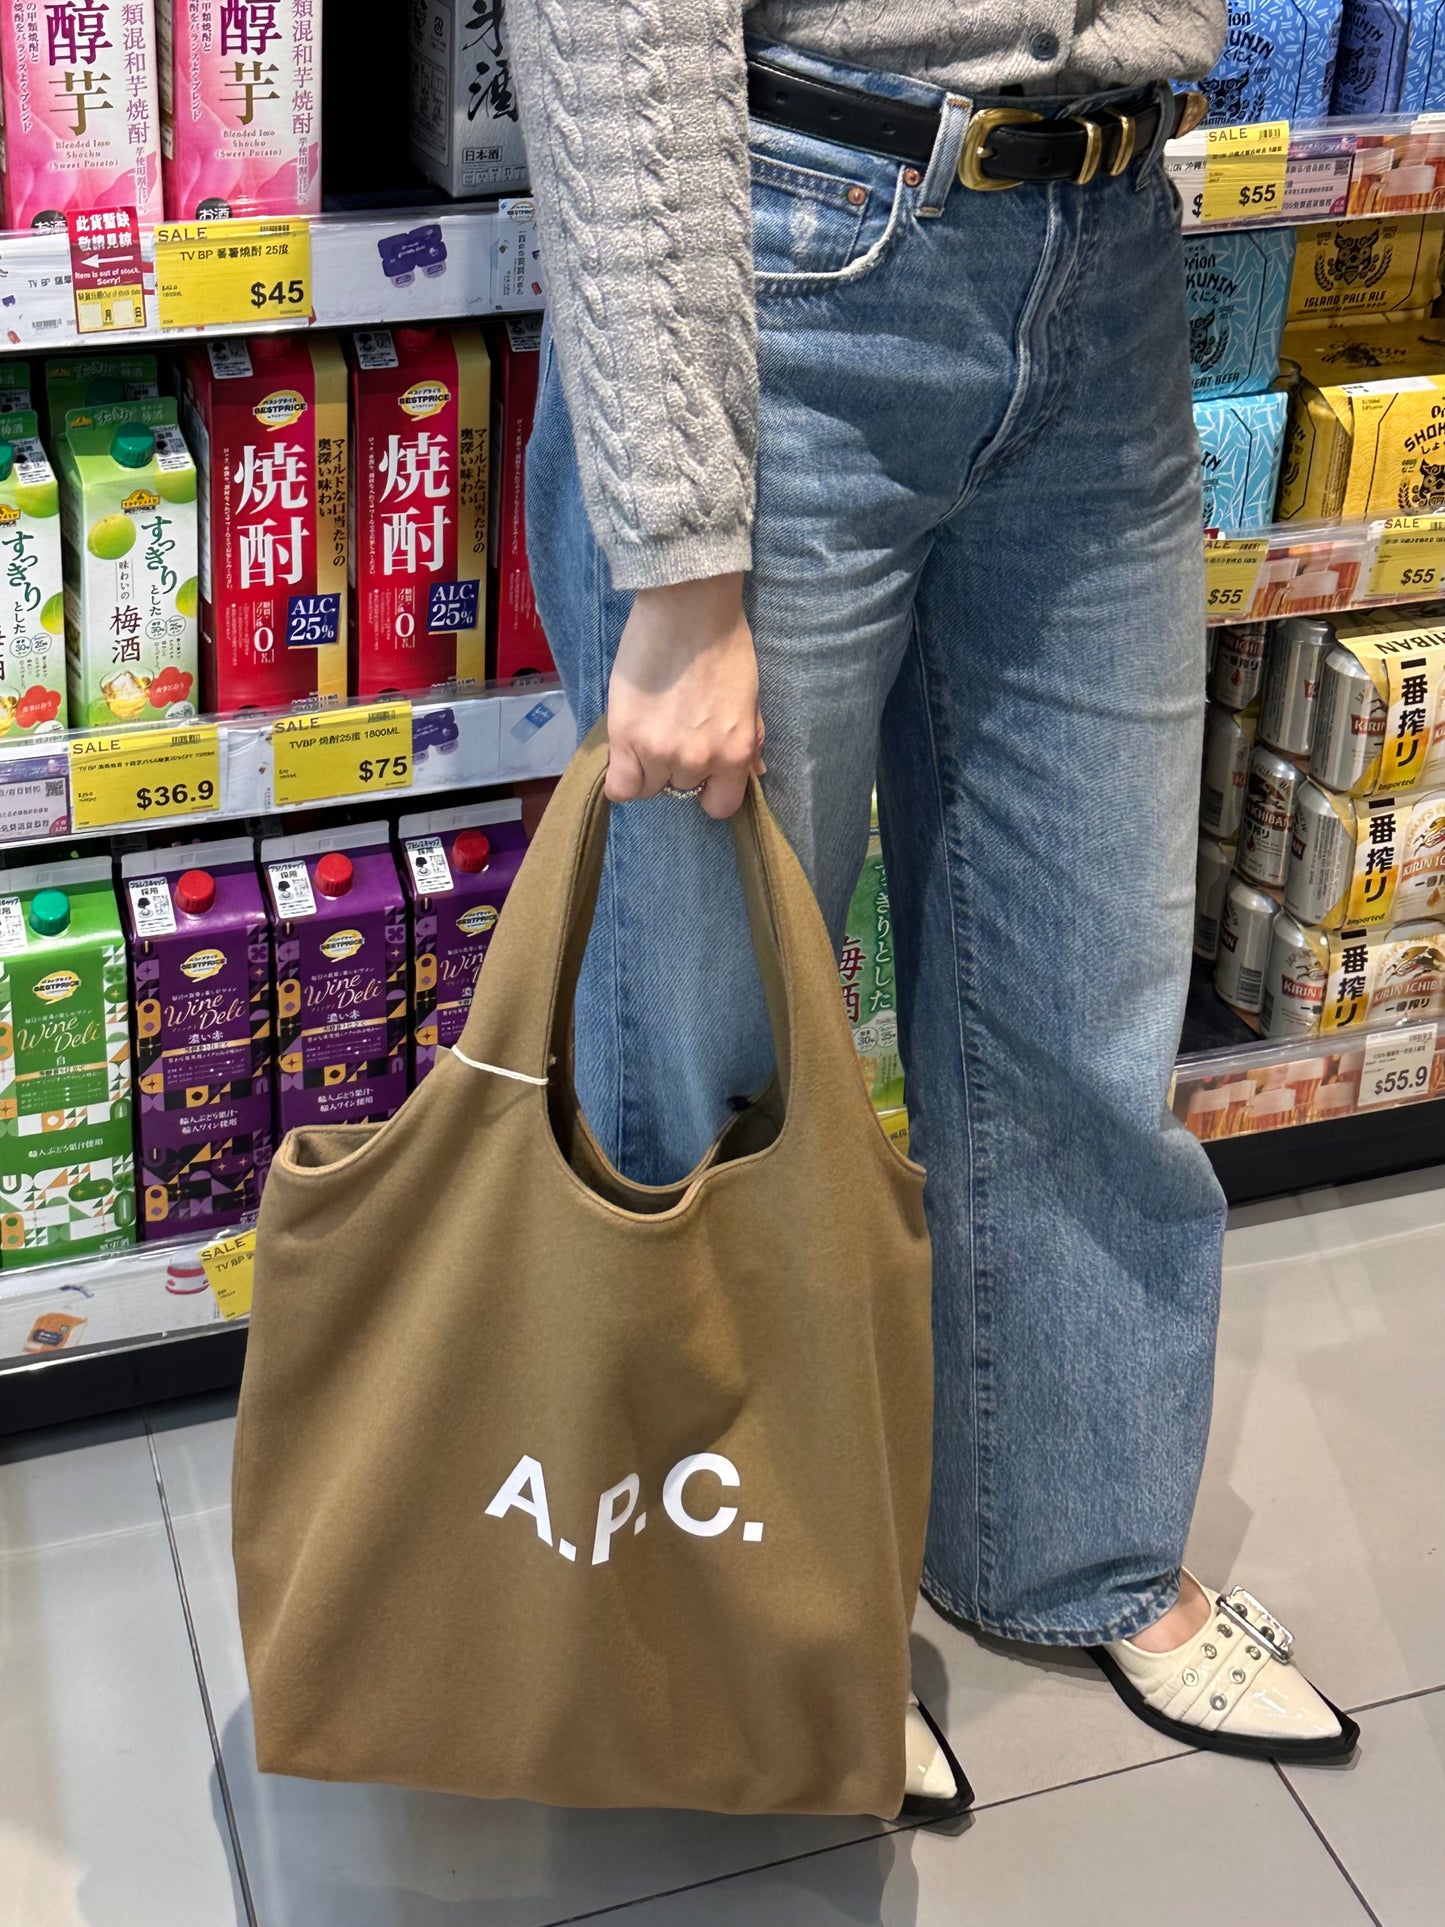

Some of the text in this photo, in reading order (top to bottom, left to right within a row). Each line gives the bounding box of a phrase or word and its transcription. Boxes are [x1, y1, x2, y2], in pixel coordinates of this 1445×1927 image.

[1208, 128, 1248, 142] SALE
[464, 149, 500, 162] 日本酒
[1239, 184, 1276, 207] $55
[75, 211, 131, 232] 此貨暫缺
[77, 232, 133, 252] 敬請見諒
[158, 227, 208, 242] SALE
[180, 251, 195, 261] TV
[198, 250, 214, 260] BP
[96, 276, 121, 286] Sorry!
[1186, 272, 1239, 298] KUNIN
[251, 280, 304, 309] $45
[1304, 290, 1387, 308] ISLAND PALE ALE
[1214, 372, 1239, 386] BEER
[254, 402, 307, 415] BESTPRICE
[398, 393, 450, 405] BESTPRICE
[318, 438, 333, 518] 奥深い味わい
[460, 428, 474, 506] 奥深い味わい
[472, 427, 488, 554] マイルドな口当たりの
[332, 438, 346, 567] マイルドな口当たりの
[378, 432, 452, 576] 焼酎
[233, 442, 311, 590] 焼酎
[1384, 518, 1421, 529] SALE
[1204, 540, 1232, 550] ALE
[141, 516, 178, 617] すっきりとした
[1401, 568, 1435, 586] $55
[1, 531, 42, 635] すっきりとした
[118, 560, 130, 600] 味わいの
[432, 584, 476, 602] ALC.
[1208, 589, 1243, 606] $55
[430, 602, 474, 627] 25%
[110, 604, 142, 664] 梅酒
[290, 616, 335, 641] 25%
[1396, 657, 1428, 768] 一番搾り
[275, 717, 321, 734] SALE
[72, 740, 121, 755] SALE
[289, 739, 317, 750] TVBP
[364, 728, 400, 741] 1800ML
[359, 756, 408, 783] $75
[1378, 776, 1416, 791] Imported
[136, 780, 214, 811] $36.9
[1364, 797, 1396, 903] 一番搾り
[1347, 912, 1386, 926] Imported
[320, 939, 364, 950] BESTPRICE
[180, 957, 226, 970] BESTPRICE
[440, 951, 484, 981] Win
[33, 979, 81, 992] BESTPRICE
[1334, 928, 1369, 1027] 一番搾り
[304, 973, 360, 1007] Wine
[337, 980, 382, 1010] Deli
[1284, 981, 1317, 998] KIRIN
[164, 993, 223, 1028] Wine
[200, 998, 247, 1030] Deli
[17, 1016, 80, 1051] Wine
[54, 1020, 100, 1053] Deli
[188, 1030, 224, 1045] 濃い赤
[1374, 1065, 1428, 1096] $55.9
[201, 1239, 246, 1261] SALE
[216, 1261, 229, 1272] TV
[484, 1453, 764, 1565] A.P.C.
